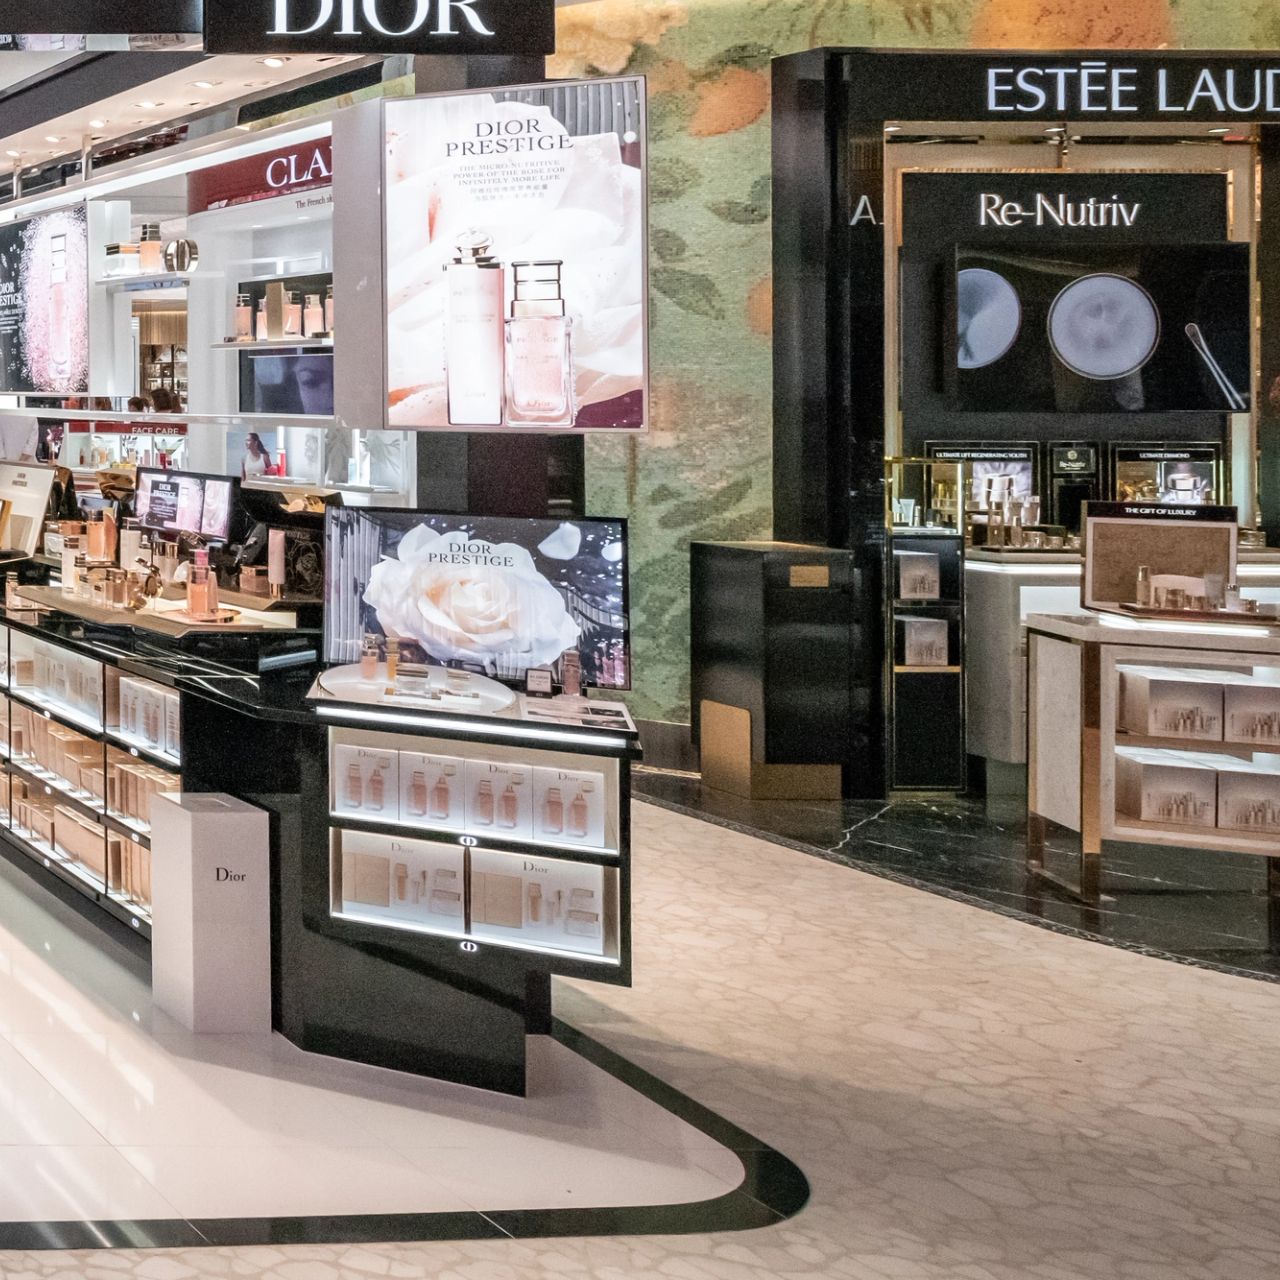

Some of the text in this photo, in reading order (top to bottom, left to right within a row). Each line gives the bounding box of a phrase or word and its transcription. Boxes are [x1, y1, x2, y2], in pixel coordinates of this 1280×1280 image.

[476, 119, 541, 137] DIOR
[446, 135, 574, 157] PRESTIGE
[266, 146, 332, 187] CLA
[980, 193, 1141, 227] Re-Nutriv
[132, 427, 153, 435] FACE
[449, 542, 491, 555] DIOR
[428, 552, 514, 567] PRESTIGE
[215, 866, 246, 881] Dior
[522, 860, 549, 874] Dior
